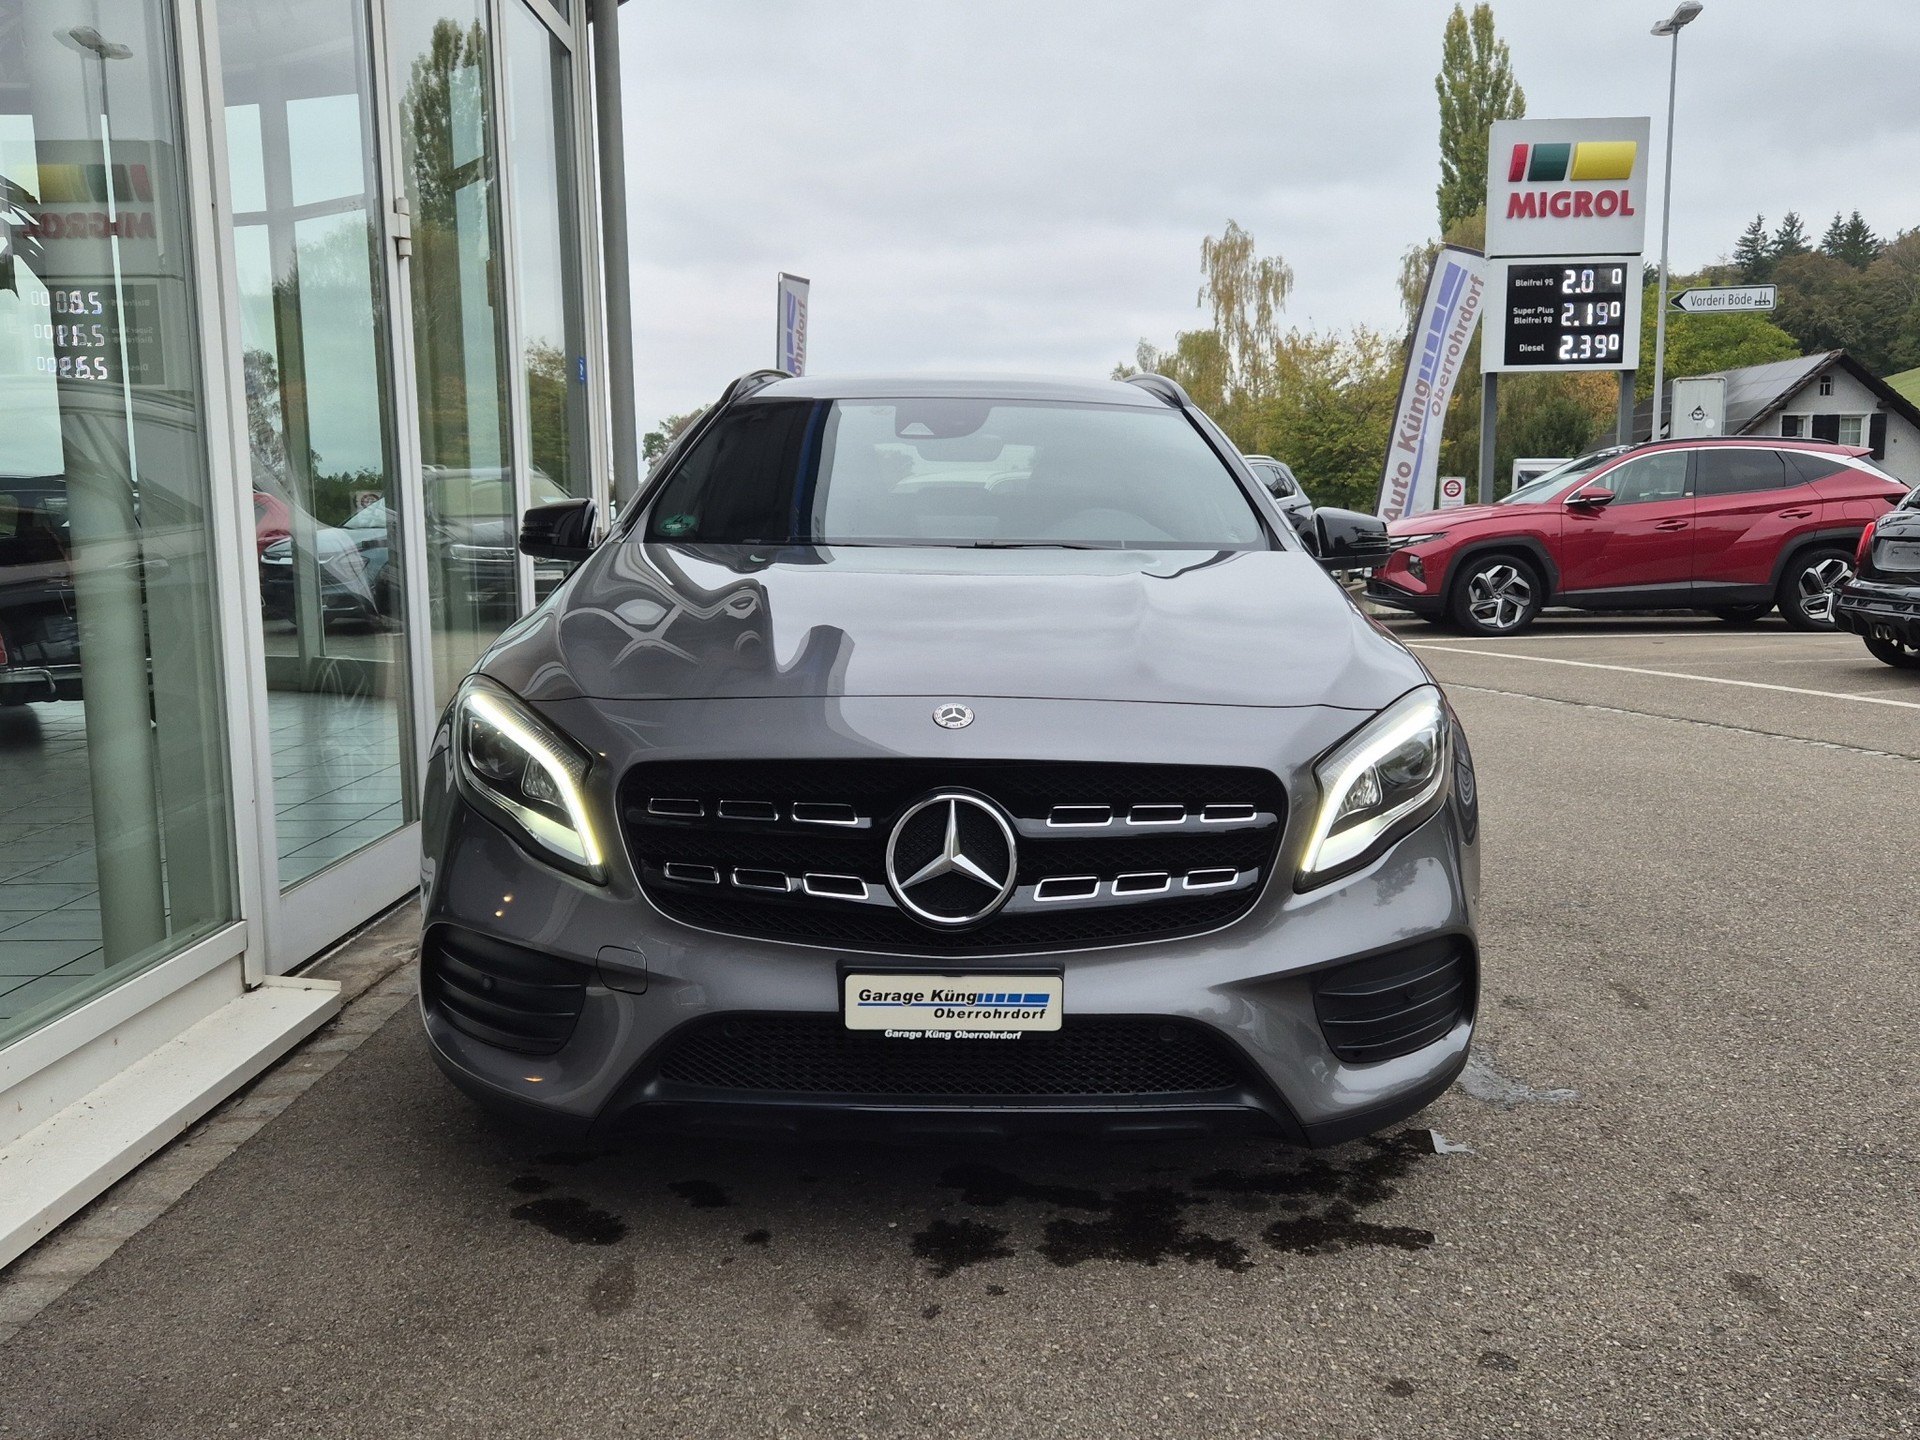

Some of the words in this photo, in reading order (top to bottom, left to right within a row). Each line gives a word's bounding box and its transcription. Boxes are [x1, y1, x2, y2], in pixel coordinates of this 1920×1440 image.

[1506, 190, 1635, 219] MIGROL
[1515, 279, 1543, 287] Bleifrei
[1544, 278, 1554, 286] 95
[1690, 295, 1725, 307] Vorderi
[1728, 293, 1752, 306] Böde
[1513, 307, 1535, 315] Super
[1537, 306, 1554, 314] Plus
[1431, 273, 1485, 417] Oberrohrdorf
[1519, 344, 1545, 352] Diesel
[1559, 334, 1619, 359] 2.390
[1383, 461, 1412, 522] Auto
[1398, 380, 1431, 454] Küng
[858, 989, 924, 1004] Garage
[930, 989, 977, 1005] Küng
[934, 1008, 1046, 1019] Oberrohrdorf
[884, 1029, 922, 1039] Garage
[925, 1029, 952, 1040] Küng
[954, 1030, 1022, 1040] Oberrohrdorf
